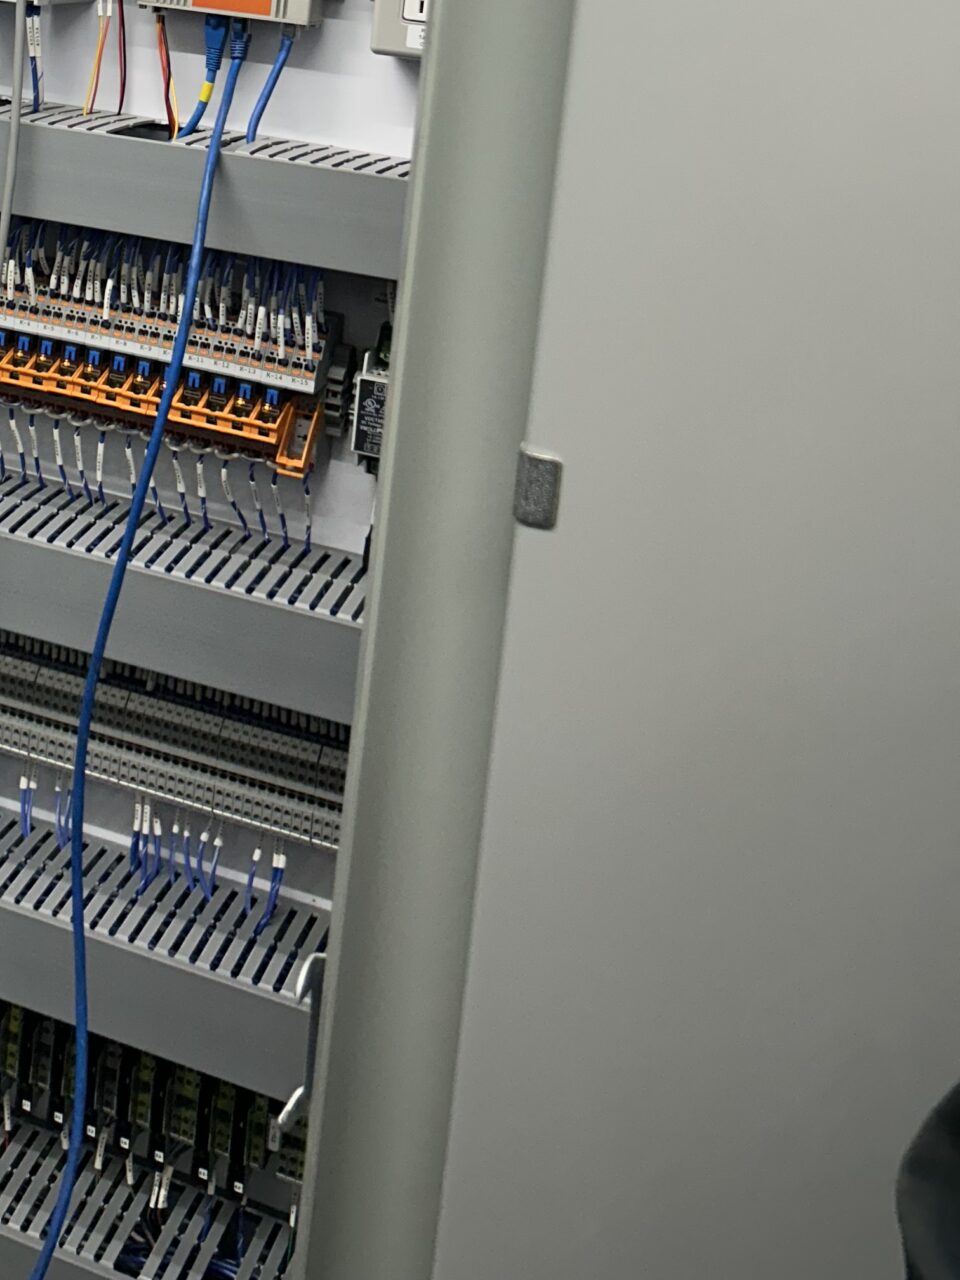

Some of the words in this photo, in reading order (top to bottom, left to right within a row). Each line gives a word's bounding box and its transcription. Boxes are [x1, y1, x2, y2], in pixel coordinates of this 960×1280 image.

[213, 360, 230, 369] K-12
[266, 371, 283, 380] K-14
[291, 377, 309, 386] K-15
